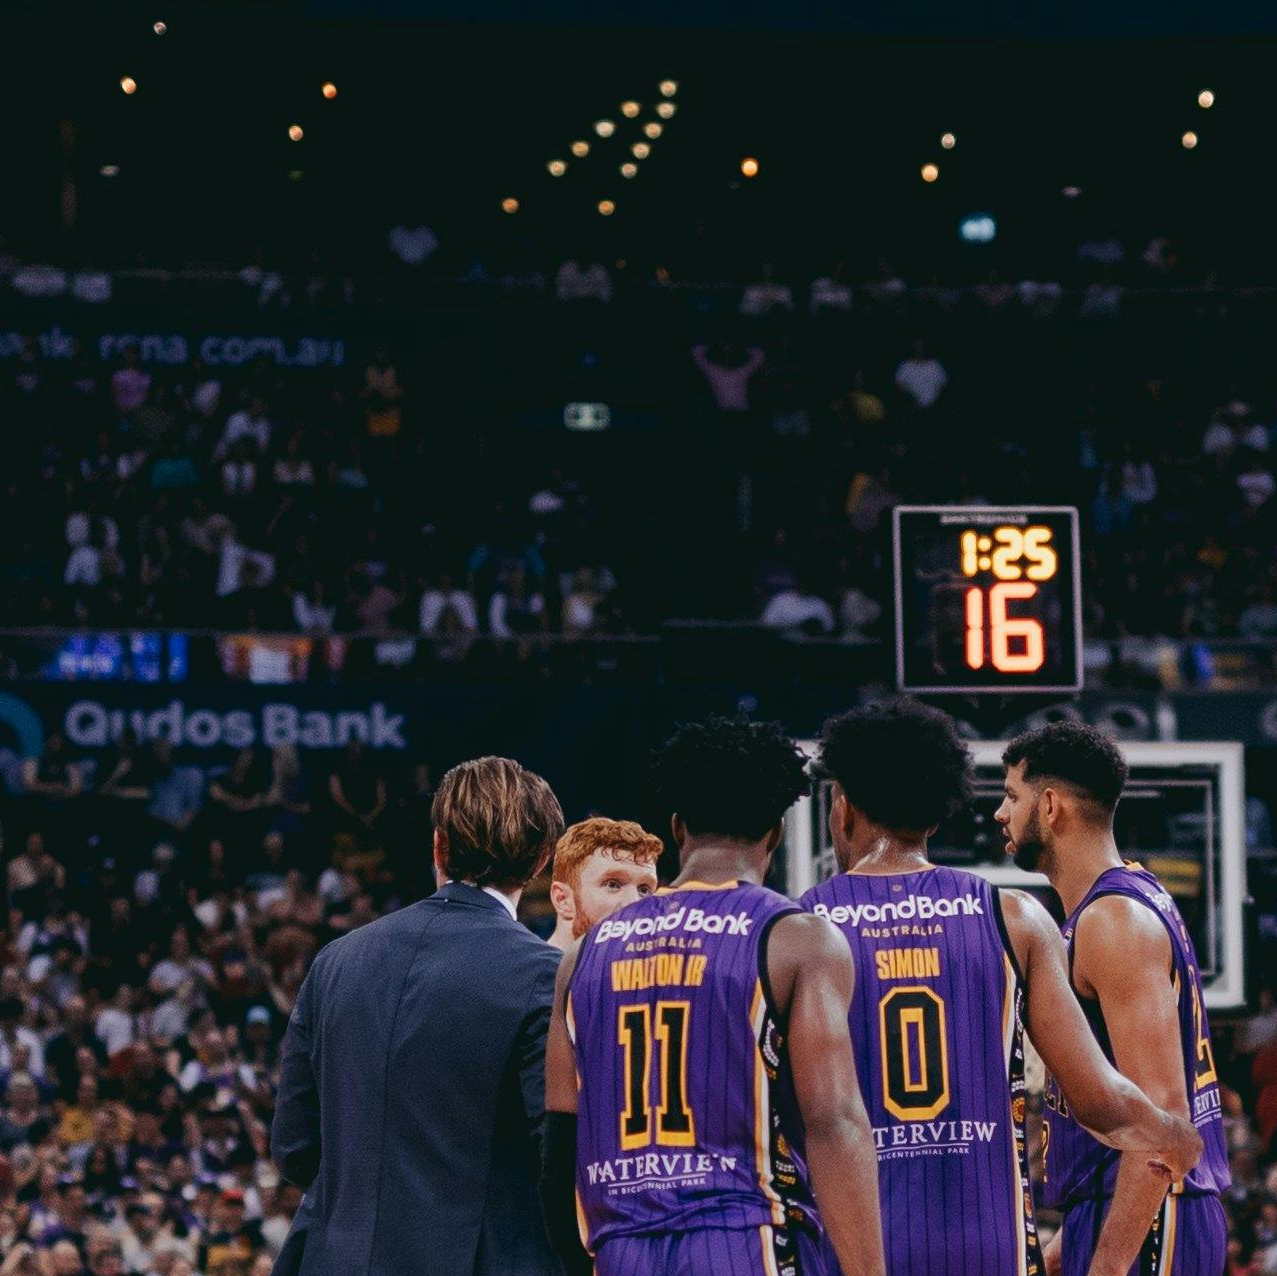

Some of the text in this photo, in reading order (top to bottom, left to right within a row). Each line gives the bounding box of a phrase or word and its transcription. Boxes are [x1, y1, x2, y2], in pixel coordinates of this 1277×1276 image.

[959, 524, 1060, 582] 1:25
[964, 581, 1045, 675] 16
[626, 937, 702, 952] AUSTRALIA
[862, 924, 943, 938] AUSTRALIA
[875, 948, 941, 980] SIMON
[879, 985, 950, 1121] 0
[618, 1001, 696, 1150] 11
[873, 1121, 998, 1149] TERVIEW
[947, 1147, 970, 1156] PARK
